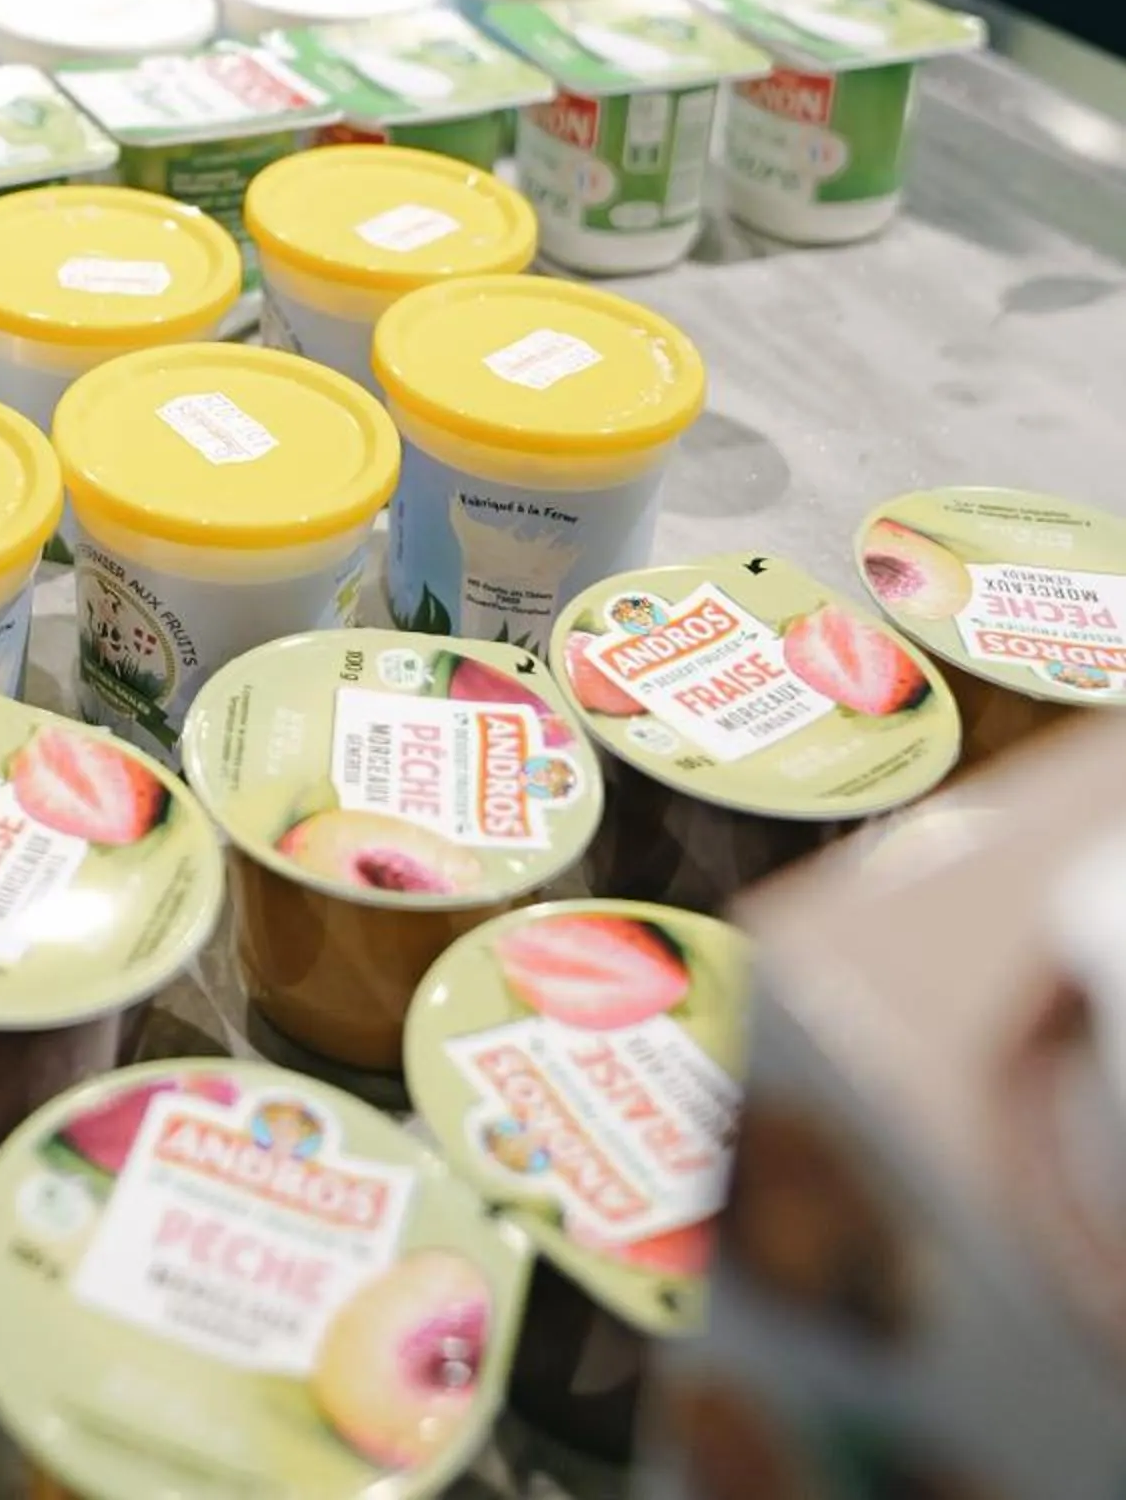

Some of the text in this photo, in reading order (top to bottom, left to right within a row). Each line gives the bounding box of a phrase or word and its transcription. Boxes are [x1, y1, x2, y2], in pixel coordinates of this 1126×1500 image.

[128, 579, 163, 611] AUX
[160, 610, 198, 668] FRUITS
[983, 578, 1099, 602] MORCEAUX
[610, 603, 732, 673] ANDROS
[983, 631, 1126, 671] NDROS
[673, 652, 785, 717] FRAISE
[715, 680, 806, 732] MORCEAUX
[365, 722, 391, 803] MORCEAUX
[485, 716, 522, 834] ANDROS
[161, 1122, 376, 1221] ANDROS
